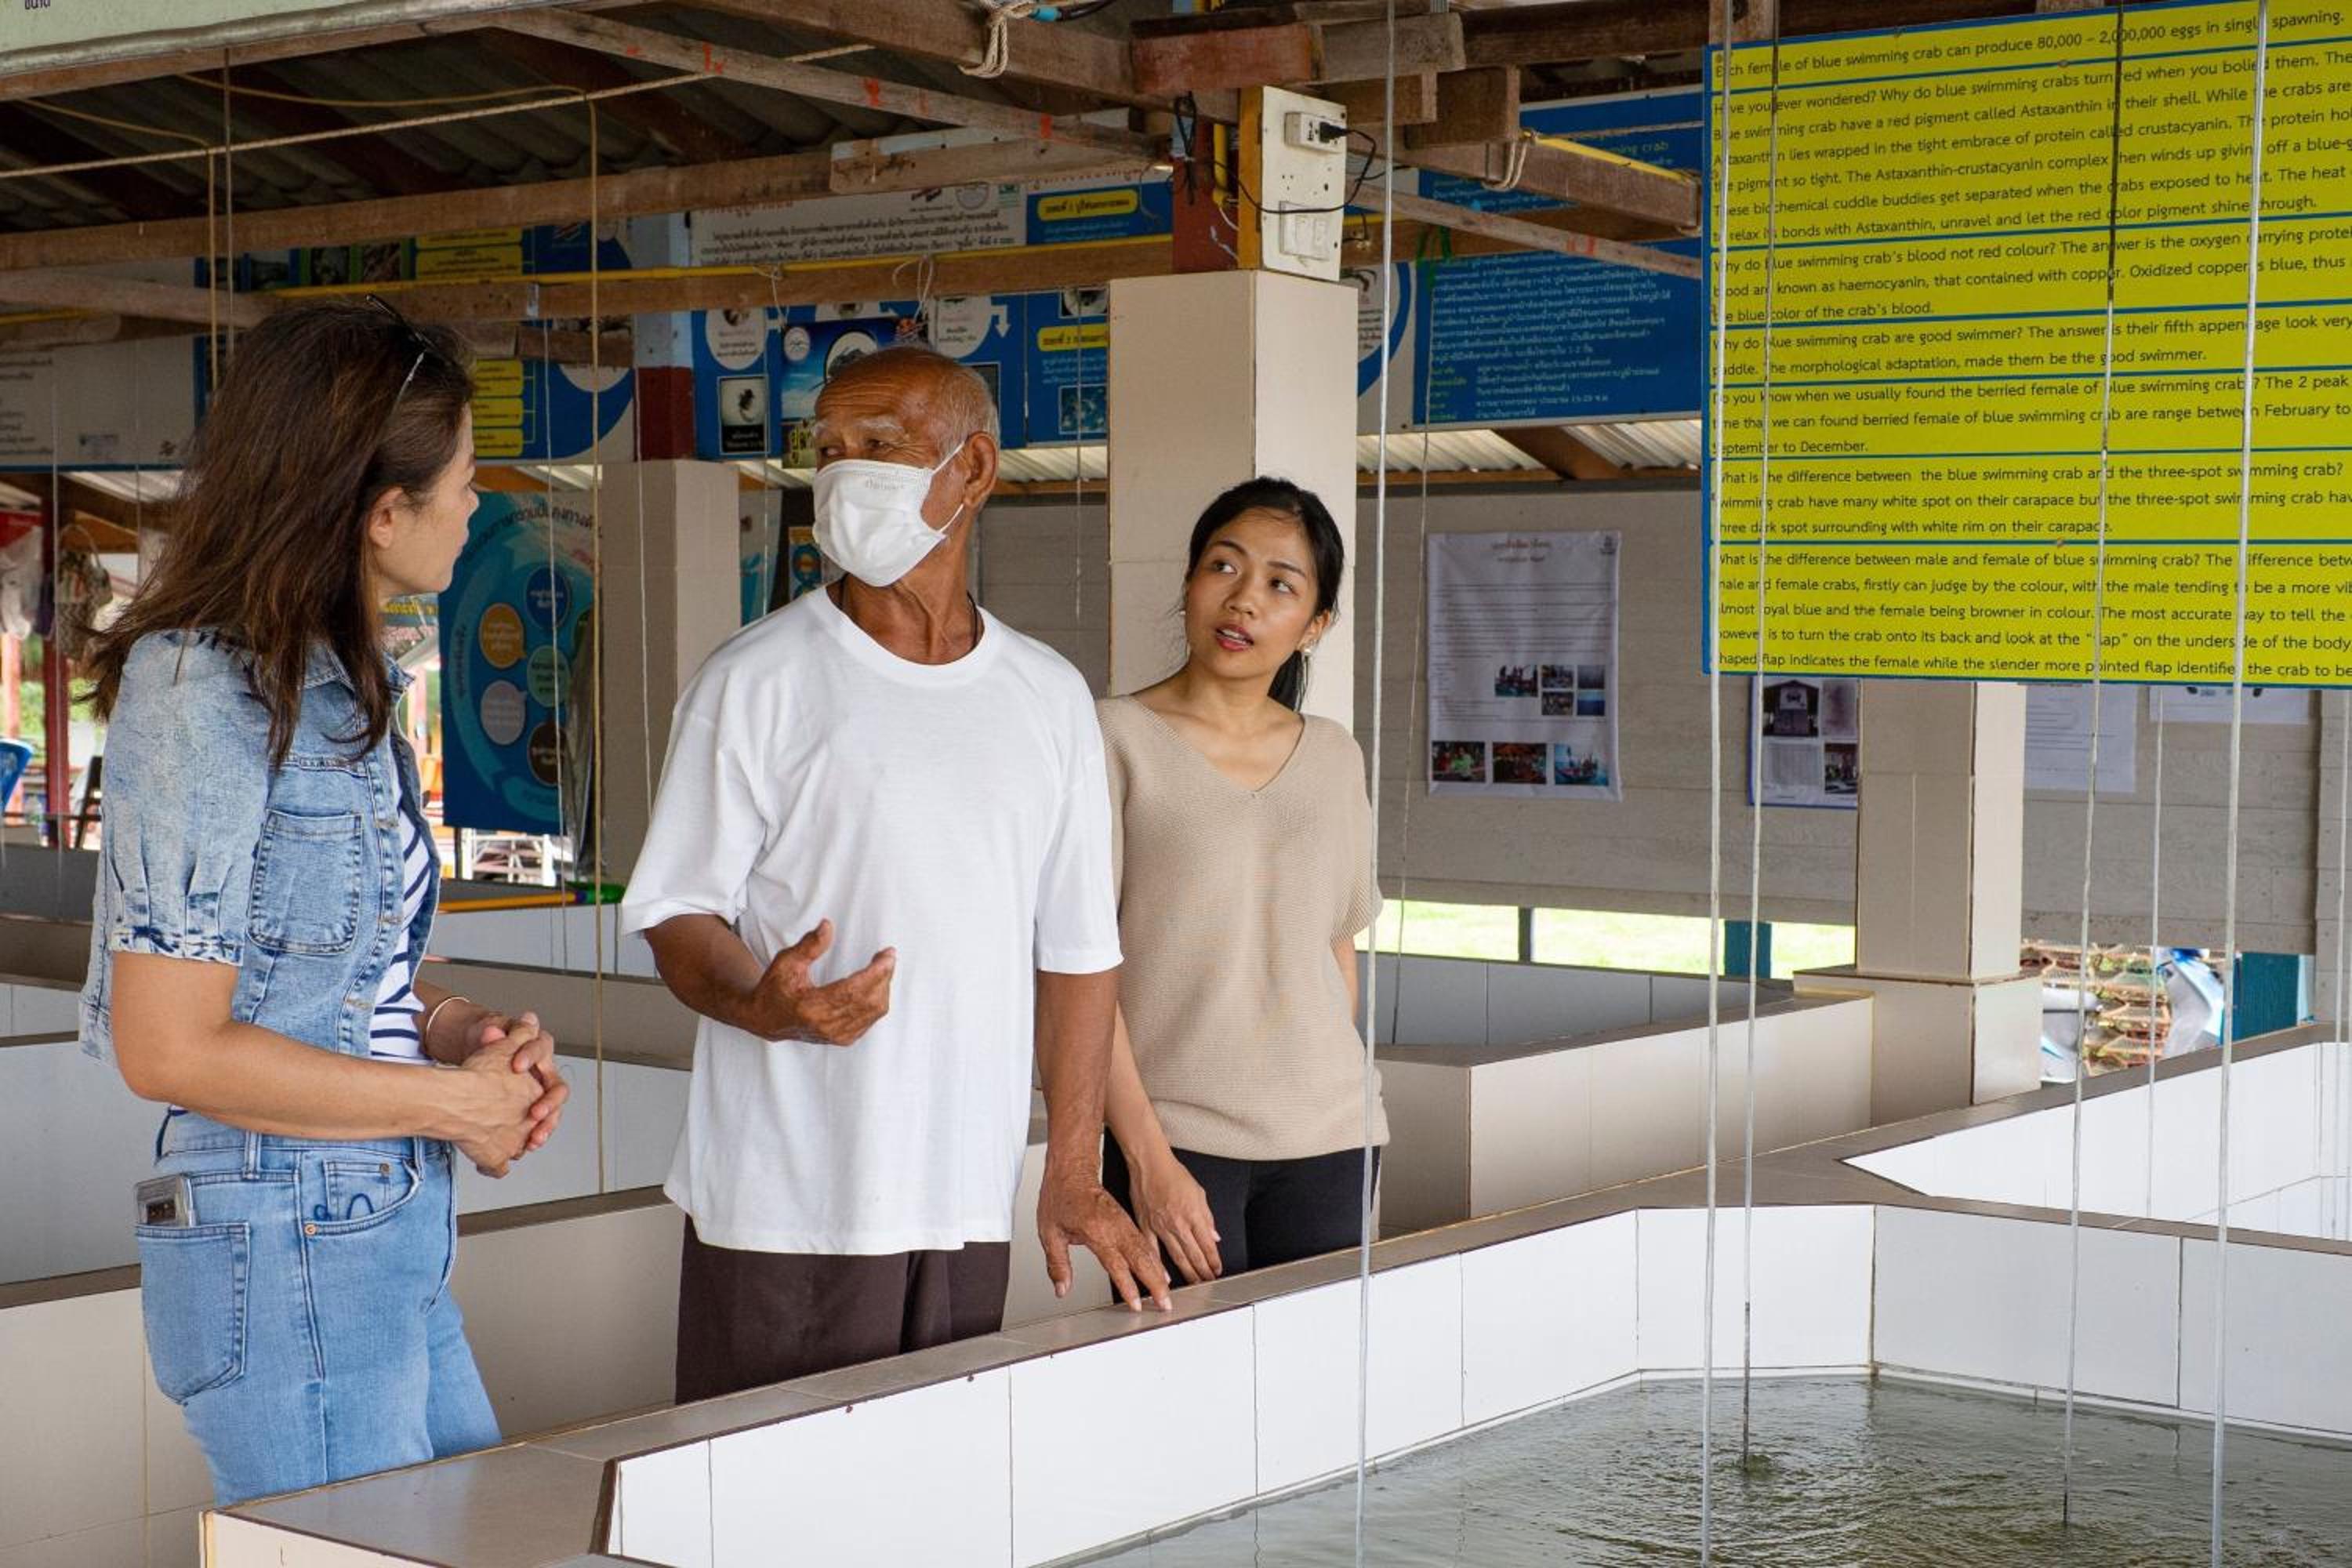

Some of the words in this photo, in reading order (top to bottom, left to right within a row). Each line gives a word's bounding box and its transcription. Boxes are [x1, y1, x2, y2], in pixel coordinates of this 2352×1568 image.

[1812, 56, 1841, 69] blue
[1846, 49, 1909, 65] swimming
[1913, 47, 1942, 60] crab
[1947, 46, 1970, 57] can
[1975, 39, 2033, 57] produce
[2037, 33, 2082, 49] 80,000
[2170, 26, 2201, 40] eggs
[2272, 10, 2344, 31] spawning.
[1806, 90, 1876, 108] wondered?
[1879, 88, 1909, 102] Why
[1935, 84, 1966, 98] blue
[1971, 78, 2037, 95] swimming
[2042, 74, 2079, 89] crabs
[2146, 67, 2185, 79] when
[2190, 65, 2217, 78] you
[2275, 56, 2319, 69] them.
[1809, 120, 1836, 134] crab
[1840, 120, 1871, 130] have
[1888, 115, 1910, 127] red
[1915, 111, 1969, 127] pigment
[1973, 106, 2016, 121] called
[2020, 100, 2102, 117] Astaxanthin
[2125, 95, 2158, 109] their
[2163, 90, 2201, 107] shell.
[2206, 87, 2247, 103] While
[2281, 82, 2322, 97] crabs
[1790, 150, 1810, 160] lies
[1814, 143, 1869, 160] wrapped
[1917, 137, 1947, 153] tight
[1951, 136, 2010, 149] embrace
[2034, 128, 2085, 145] protein
[2137, 118, 2232, 136] crustacyanin.
[2270, 110, 2325, 129] protein
[1809, 173, 1842, 187] tight.
[1875, 158, 2042, 180] Astaxanthin-crustacyanin
[2047, 154, 2108, 170] complex
[2151, 147, 2190, 162] winds
[1833, 195, 1878, 209] cuddle
[1882, 193, 1935, 206] buddies
[1965, 187, 2032, 203] separated
[2036, 186, 2074, 197] when
[2149, 173, 2209, 192] exposed
[2311, 165, 2346, 179] heat
[1730, 227, 1759, 241] relax
[1781, 225, 1820, 238] bonds
[1824, 223, 1851, 235] with
[1856, 219, 1935, 234] Astaxanthin,
[1940, 215, 1991, 229] unravel
[2147, 203, 2205, 220] pigment
[2212, 200, 2250, 214] shine
[1798, 256, 1859, 267] swimming
[1907, 249, 1946, 263] blood
[2005, 242, 2056, 257] colour?
[2189, 234, 2241, 249] oxygen
[1777, 281, 1817, 294] known
[1838, 276, 1929, 291] haemocyanin,
[1933, 275, 1961, 286] that
[1965, 270, 2033, 285] contained
[2038, 269, 2067, 282] with
[2129, 263, 2192, 278] Oxidized
[2197, 263, 2250, 277] copper
[2270, 258, 2307, 271] blue,
[2313, 256, 2345, 269] thus
[1891, 302, 1933, 318] blood.
[1796, 336, 1857, 347] swimming
[1862, 332, 1890, 345] crab
[1918, 329, 1951, 346] good
[1956, 327, 2022, 341] swimmer?
[2125, 321, 2159, 335] their
[2163, 319, 2194, 333] fifth
[2285, 315, 2318, 328] look
[1790, 359, 1882, 375] morphological
[1885, 356, 1959, 372] adaptation,
[1964, 354, 2003, 368] made
[2007, 354, 2044, 366] them
[2140, 349, 2206, 362] swimmer.
[1795, 390, 1829, 402] when
[1855, 388, 1901, 402] usually
[1905, 386, 1945, 399] found
[1976, 384, 2025, 397] berried
[2031, 382, 2078, 396] female
[2140, 379, 2209, 394] swimming
[2312, 375, 2349, 390] peak
[1819, 415, 1858, 427] found
[1862, 413, 1909, 426] berried
[1913, 412, 1960, 425] female
[1983, 411, 2013, 423] blue
[2018, 409, 2085, 424] swimming
[2152, 409, 2191, 423] range
[2264, 403, 2330, 417] February
[1800, 441, 1868, 452] December.
[1787, 470, 1851, 483] difference
[1855, 470, 1911, 482] between
[1947, 468, 1976, 481] blue
[1982, 468, 2048, 482] swimming
[2053, 466, 2083, 480] crab
[2147, 465, 2222, 481] three-spot
[2303, 463, 2343, 476] crab?
[1777, 496, 1804, 508] crab
[1809, 496, 1838, 507] have
[1842, 498, 1878, 510] many
[1882, 495, 1917, 507] white
[1922, 496, 1950, 510] spot
[1977, 495, 2009, 506] their
[2013, 496, 2074, 509] carapace
[2136, 493, 2209, 507] three-spot
[2291, 491, 2323, 504] crab
[1780, 523, 1807, 535] spot
[1812, 521, 1887, 536] surrounding
[1890, 521, 1918, 533] with
[1922, 520, 1958, 533] white
[2011, 520, 2043, 532] their
[1786, 553, 1850, 565] difference
[1855, 554, 1911, 565] between
[1915, 553, 1948, 565] male
[1982, 553, 2030, 565] female
[2053, 554, 2085, 566] blue
[2161, 554, 2200, 566] crab?
[1775, 578, 1819, 590] female
[1822, 579, 1860, 592] crabs,
[1864, 578, 1900, 593] firstly
[1930, 579, 1967, 594] judge
[2020, 580, 2067, 593] colour,
[2133, 579, 2169, 593] male
[2174, 580, 2229, 597] tending
[2291, 584, 2330, 594] more
[1793, 604, 1821, 615] blue
[1879, 604, 1925, 617] female
[1929, 604, 1965, 620] being
[1969, 604, 2024, 618] browner
[2046, 607, 2094, 619] colour.
[2131, 608, 2165, 620] most
[2171, 609, 2232, 620] accurate
[2290, 608, 2315, 621] tell
[1798, 630, 1824, 641] turn
[1853, 630, 1882, 642] crab
[1886, 632, 1917, 642] onto
[1940, 630, 1971, 644] back
[2005, 632, 2034, 644] look
[1790, 654, 1845, 666] indicates
[1874, 655, 1918, 668] female
[1923, 656, 1958, 669] while
[1990, 659, 2040, 670] slender
[2045, 662, 2080, 672] more
[2144, 660, 2172, 676] flap
[2277, 664, 2310, 677] crab
